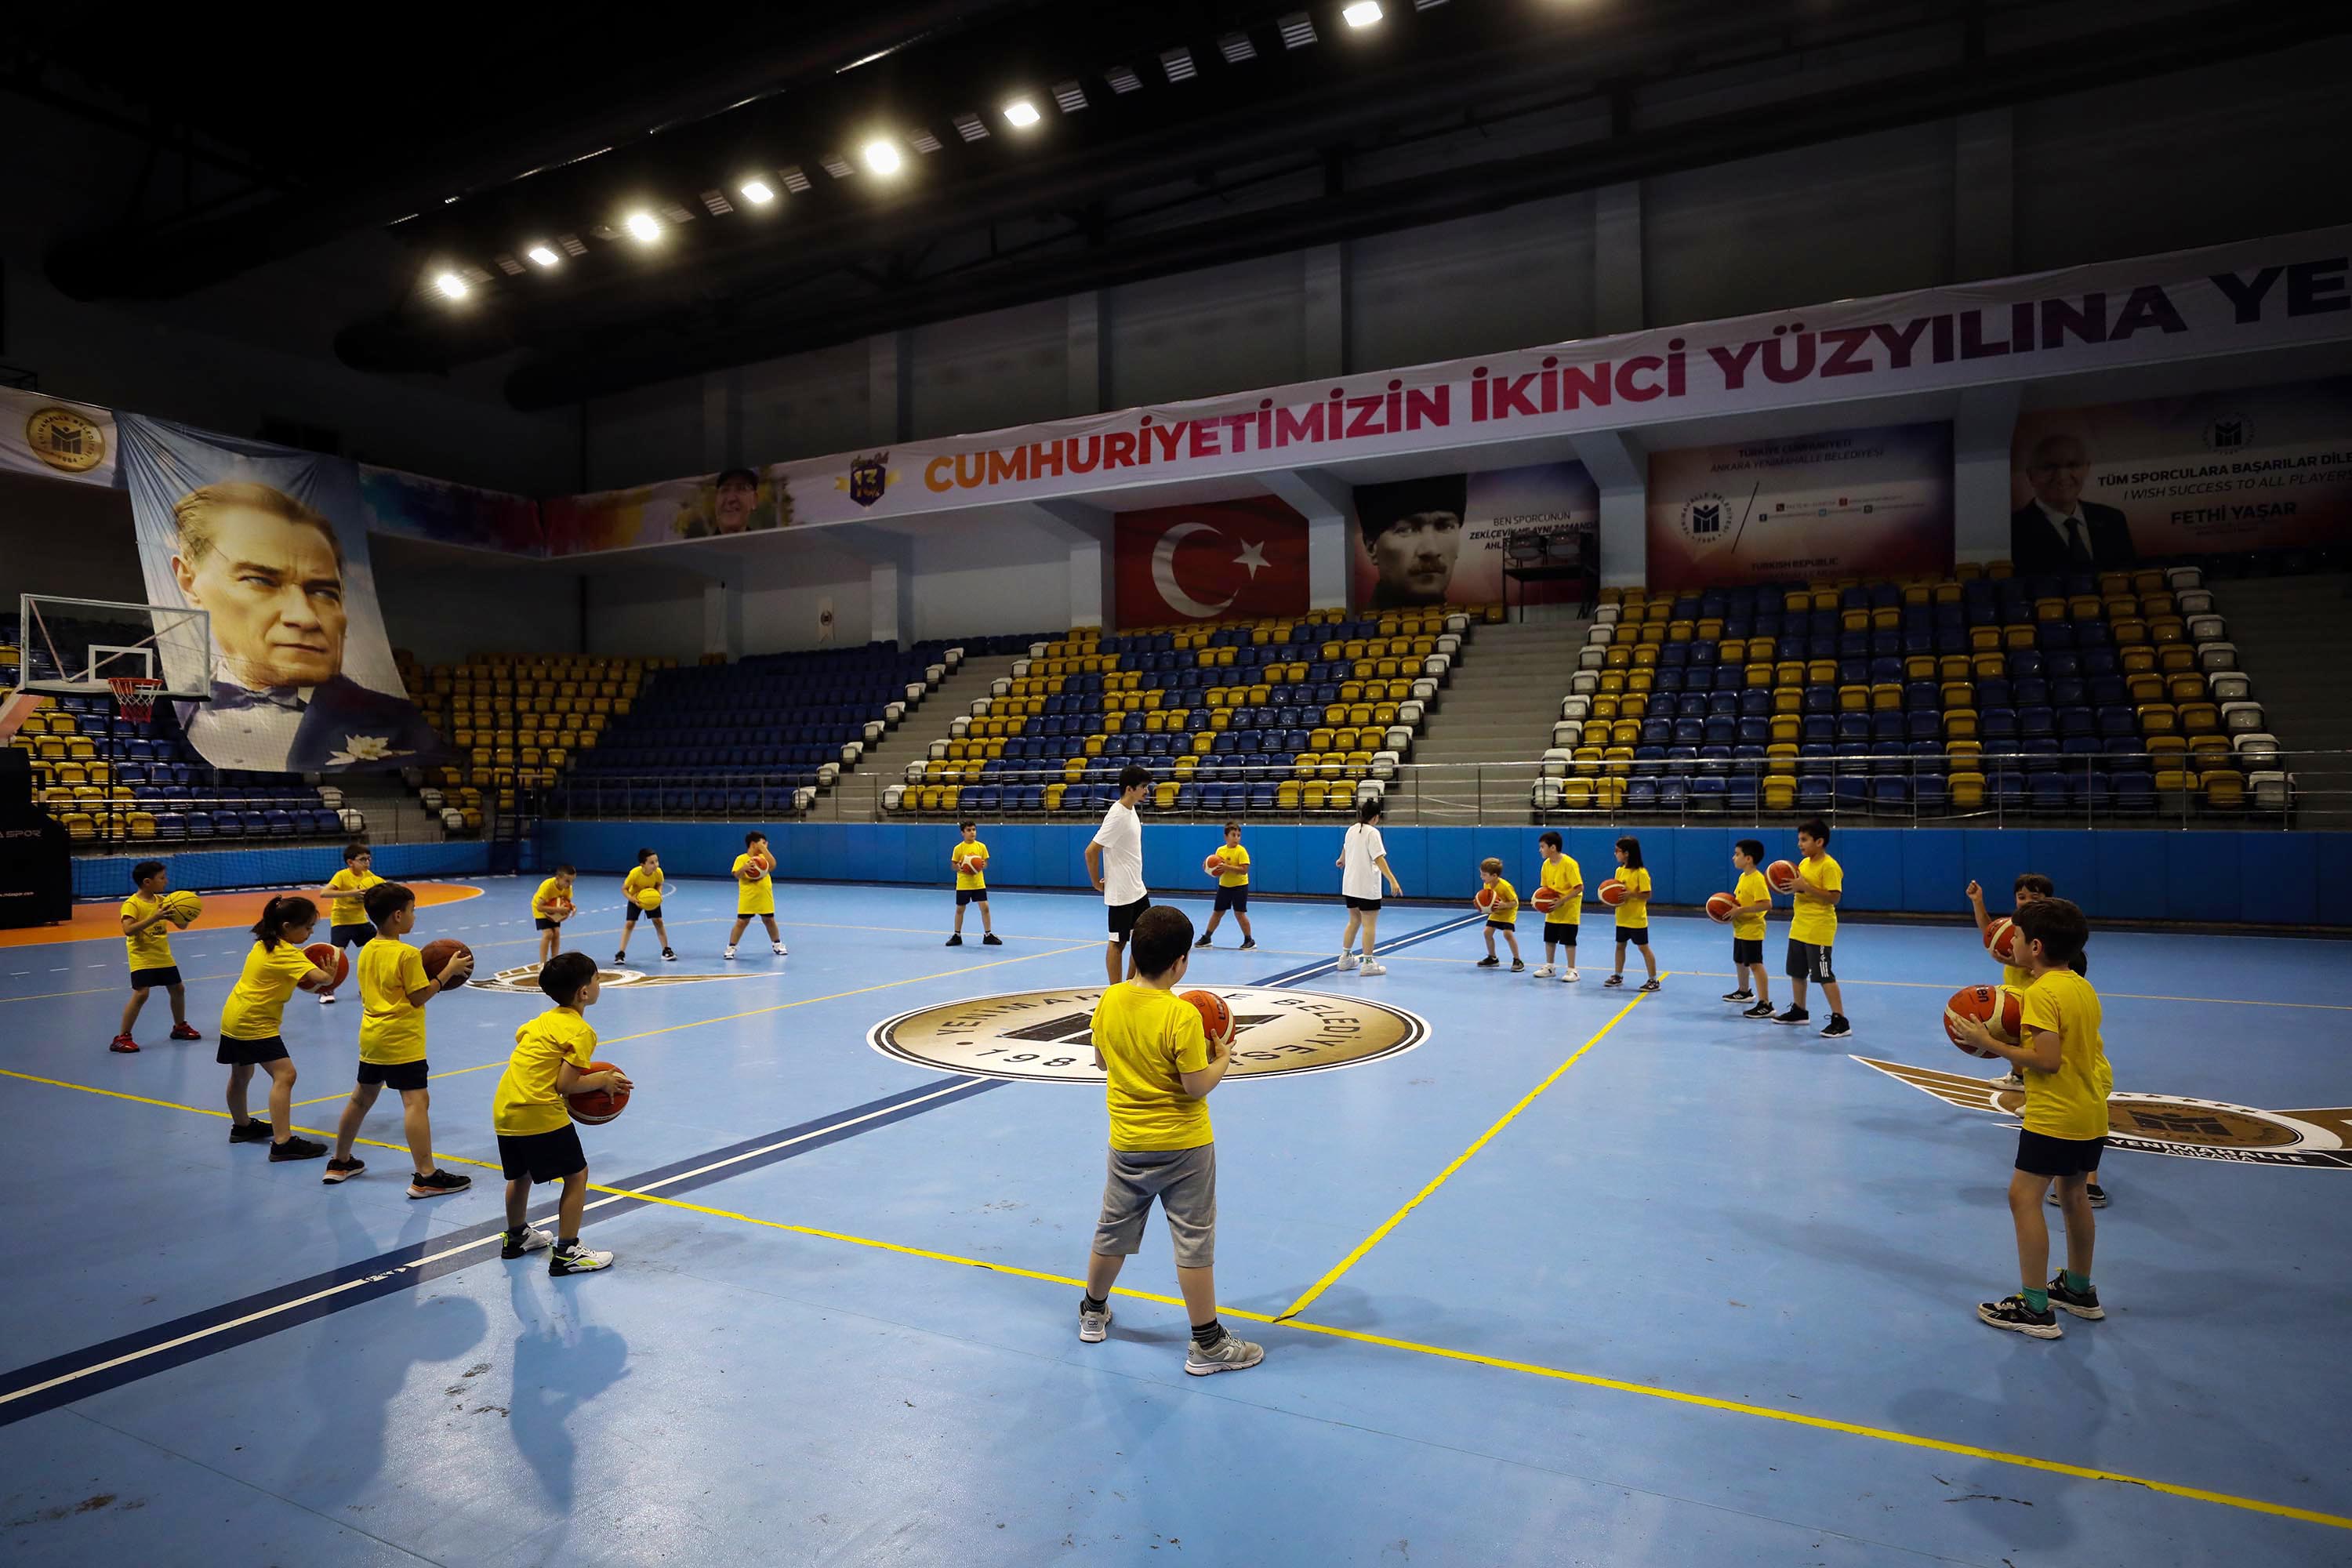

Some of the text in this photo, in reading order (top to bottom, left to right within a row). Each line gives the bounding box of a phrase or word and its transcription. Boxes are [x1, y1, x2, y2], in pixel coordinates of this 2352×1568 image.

[924, 257, 2351, 492] CUMHURİYETİMİZİN İKİNCİ YÜZYILINA YE
[2097, 473, 2128, 486] TÜM
[2131, 465, 2228, 484] SPORCULARA
[2233, 456, 2318, 475] BAŞARILAR
[2130, 488, 2166, 499] WISH
[2169, 481, 2233, 496] SUCCESS
[2237, 479, 2256, 490] TO
[2259, 476, 2285, 488] ALL
[1494, 511, 1571, 527] BEN SPORCUNUN
[2171, 502, 2298, 525] FETHİ YAŞAR
[936, 993, 1253, 1036] YENİMAHE
[975, 1048, 1098, 1067] 198
[2165, 1149, 2258, 1163] ANKARA
